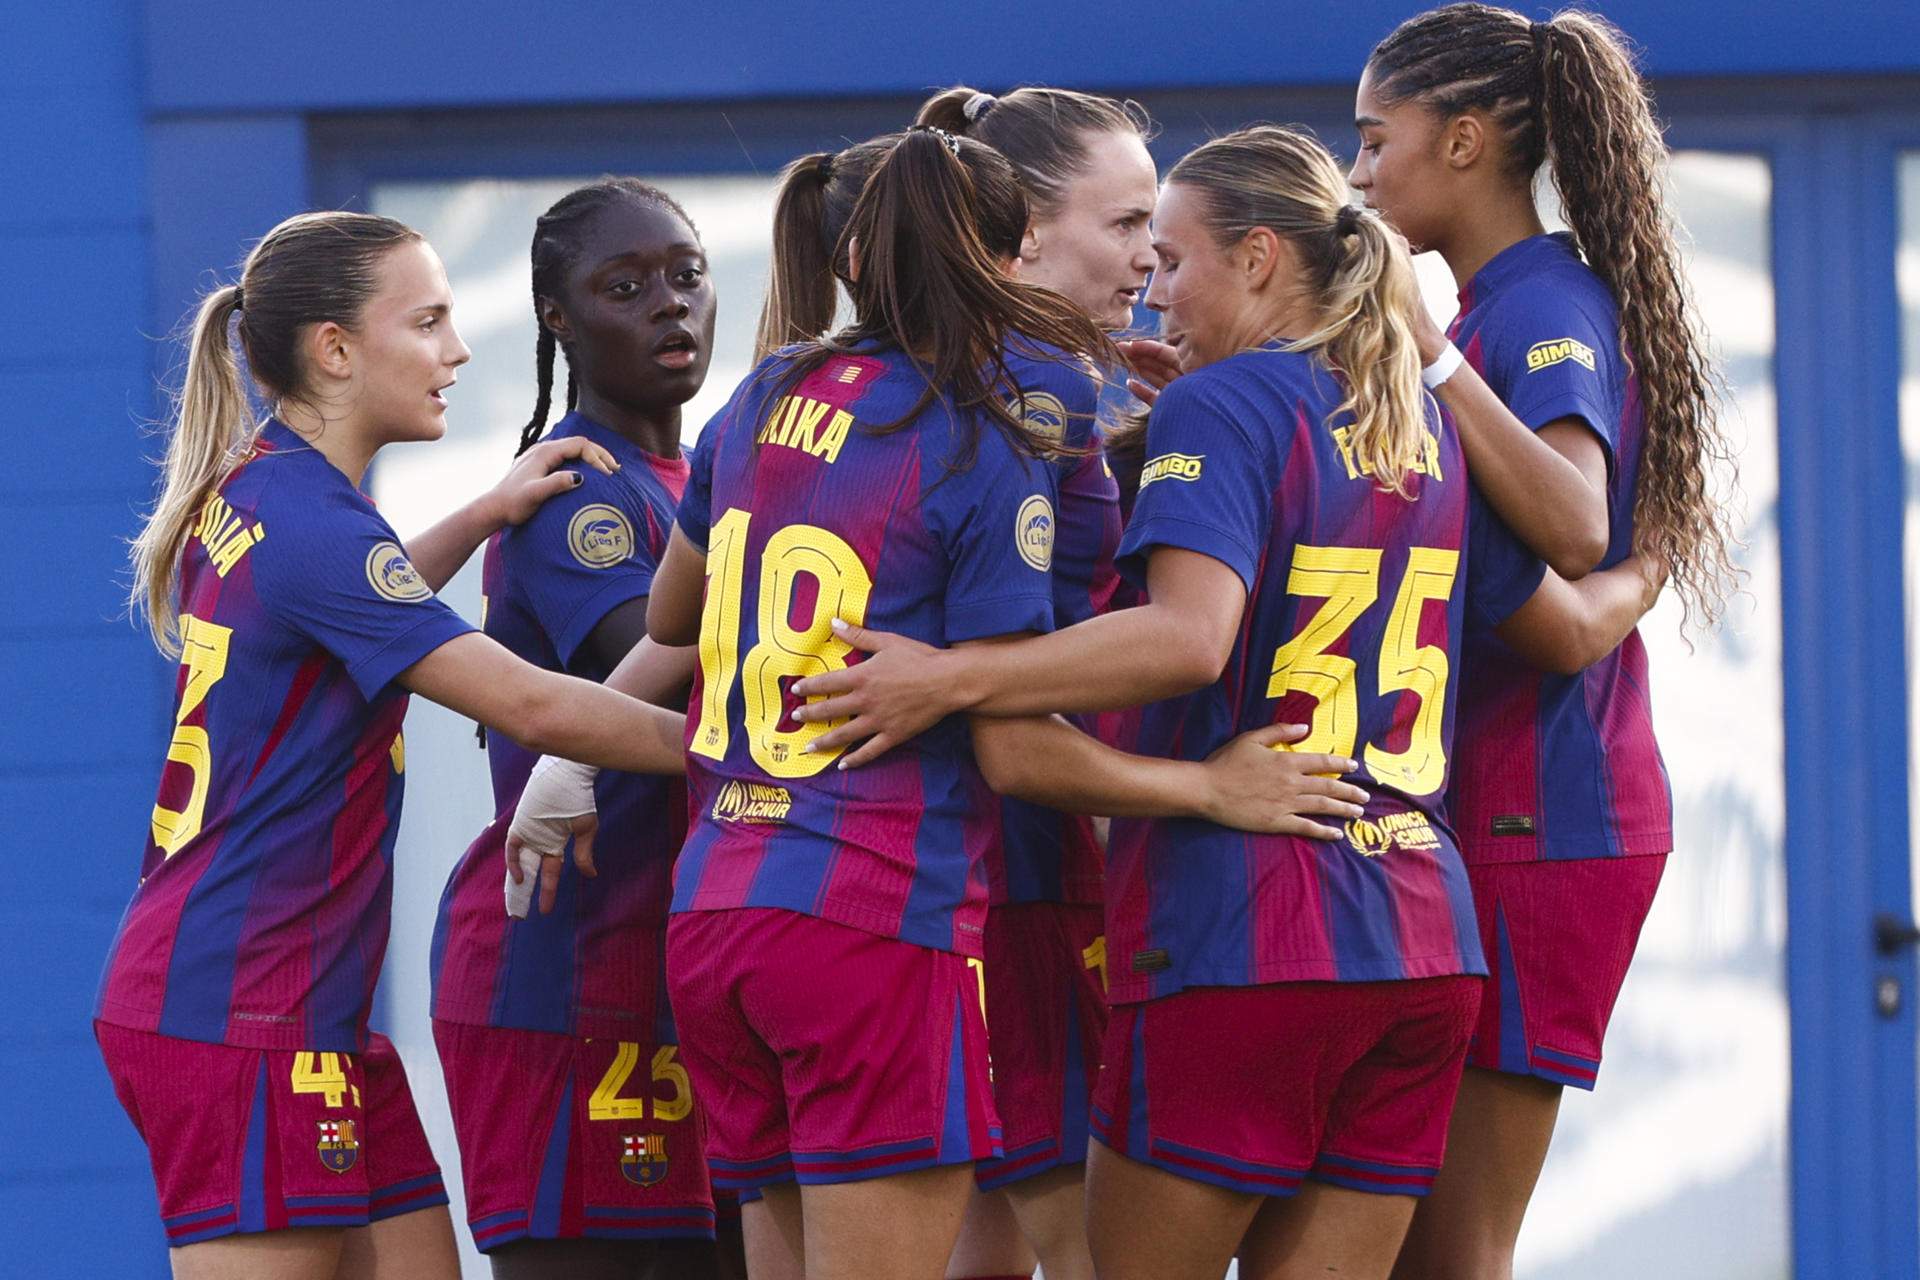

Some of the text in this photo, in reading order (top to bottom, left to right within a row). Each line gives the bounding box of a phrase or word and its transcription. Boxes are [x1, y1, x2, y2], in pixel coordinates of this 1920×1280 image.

[1527, 341, 1595, 369] BIMBO
[758, 396, 855, 464] KIKA
[1140, 457, 1202, 487] BIMBO
[689, 508, 872, 778] 18
[1265, 544, 1460, 796] 35
[748, 784, 791, 803] UNHCR
[743, 802, 791, 819] ACNUR
[1378, 811, 1429, 833] UNHCR
[291, 1051, 361, 1108] 4
